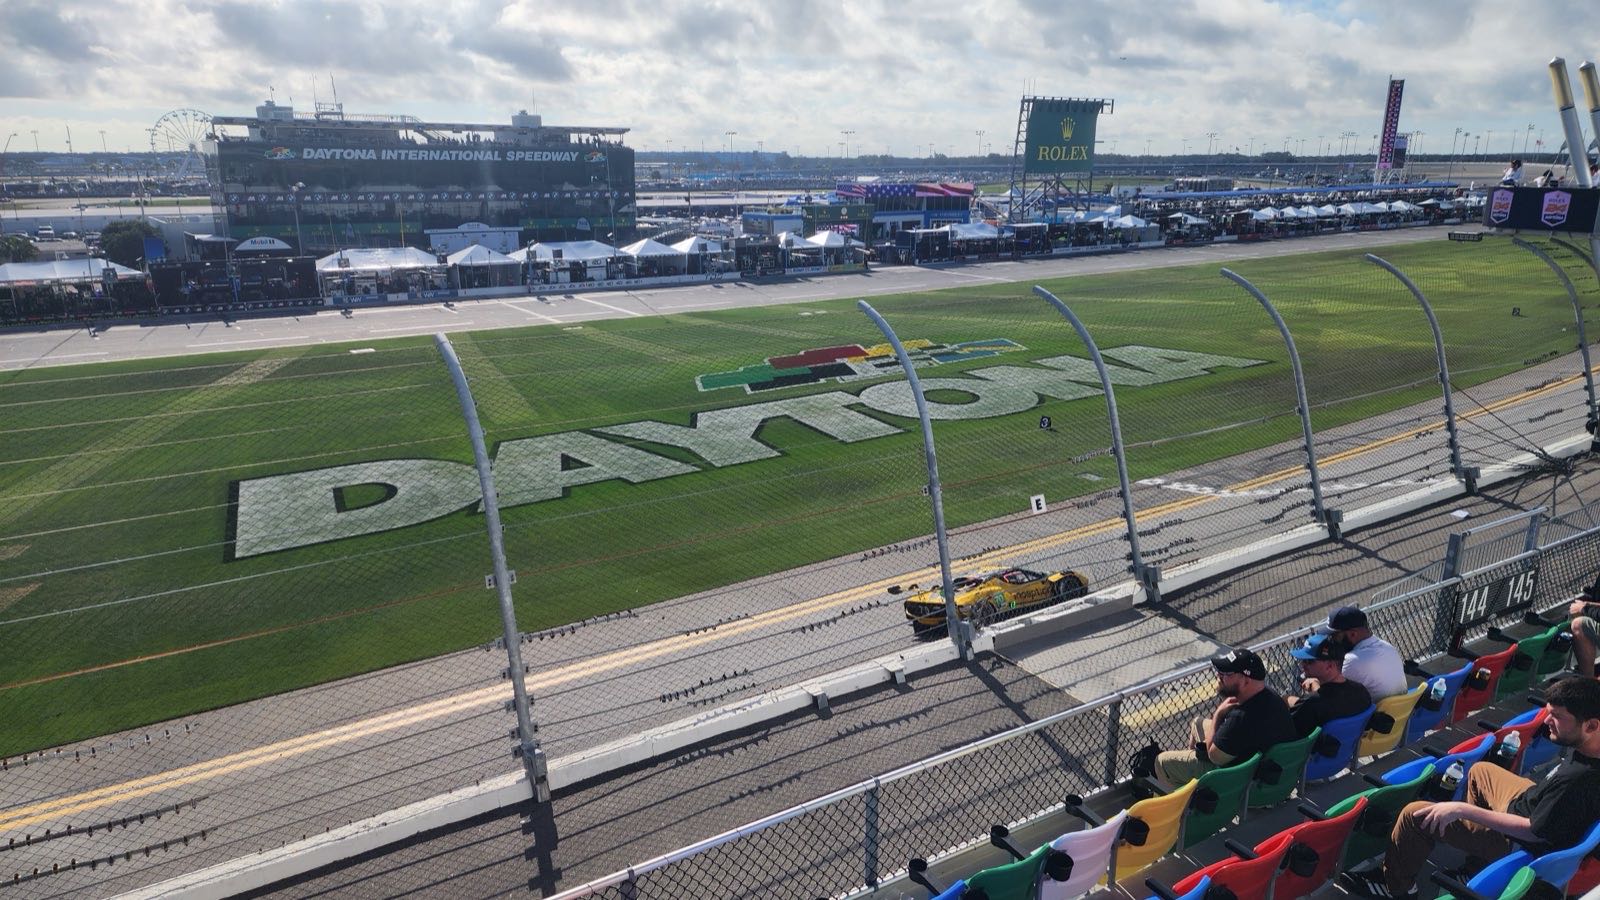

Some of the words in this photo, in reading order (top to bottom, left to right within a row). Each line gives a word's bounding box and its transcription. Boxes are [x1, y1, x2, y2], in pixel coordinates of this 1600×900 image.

[302, 148, 377, 160] DAYTONA
[381, 148, 502, 161] INTERNATIONAL
[505, 150, 580, 161] SPEEDWAY
[1037, 145, 1089, 161] ROLEX
[1041, 417, 1049, 427] 3
[230, 346, 1268, 560] DAYTONA
[1035, 498, 1043, 511] E
[1460, 585, 1489, 624] 144
[1506, 570, 1535, 607] 145
